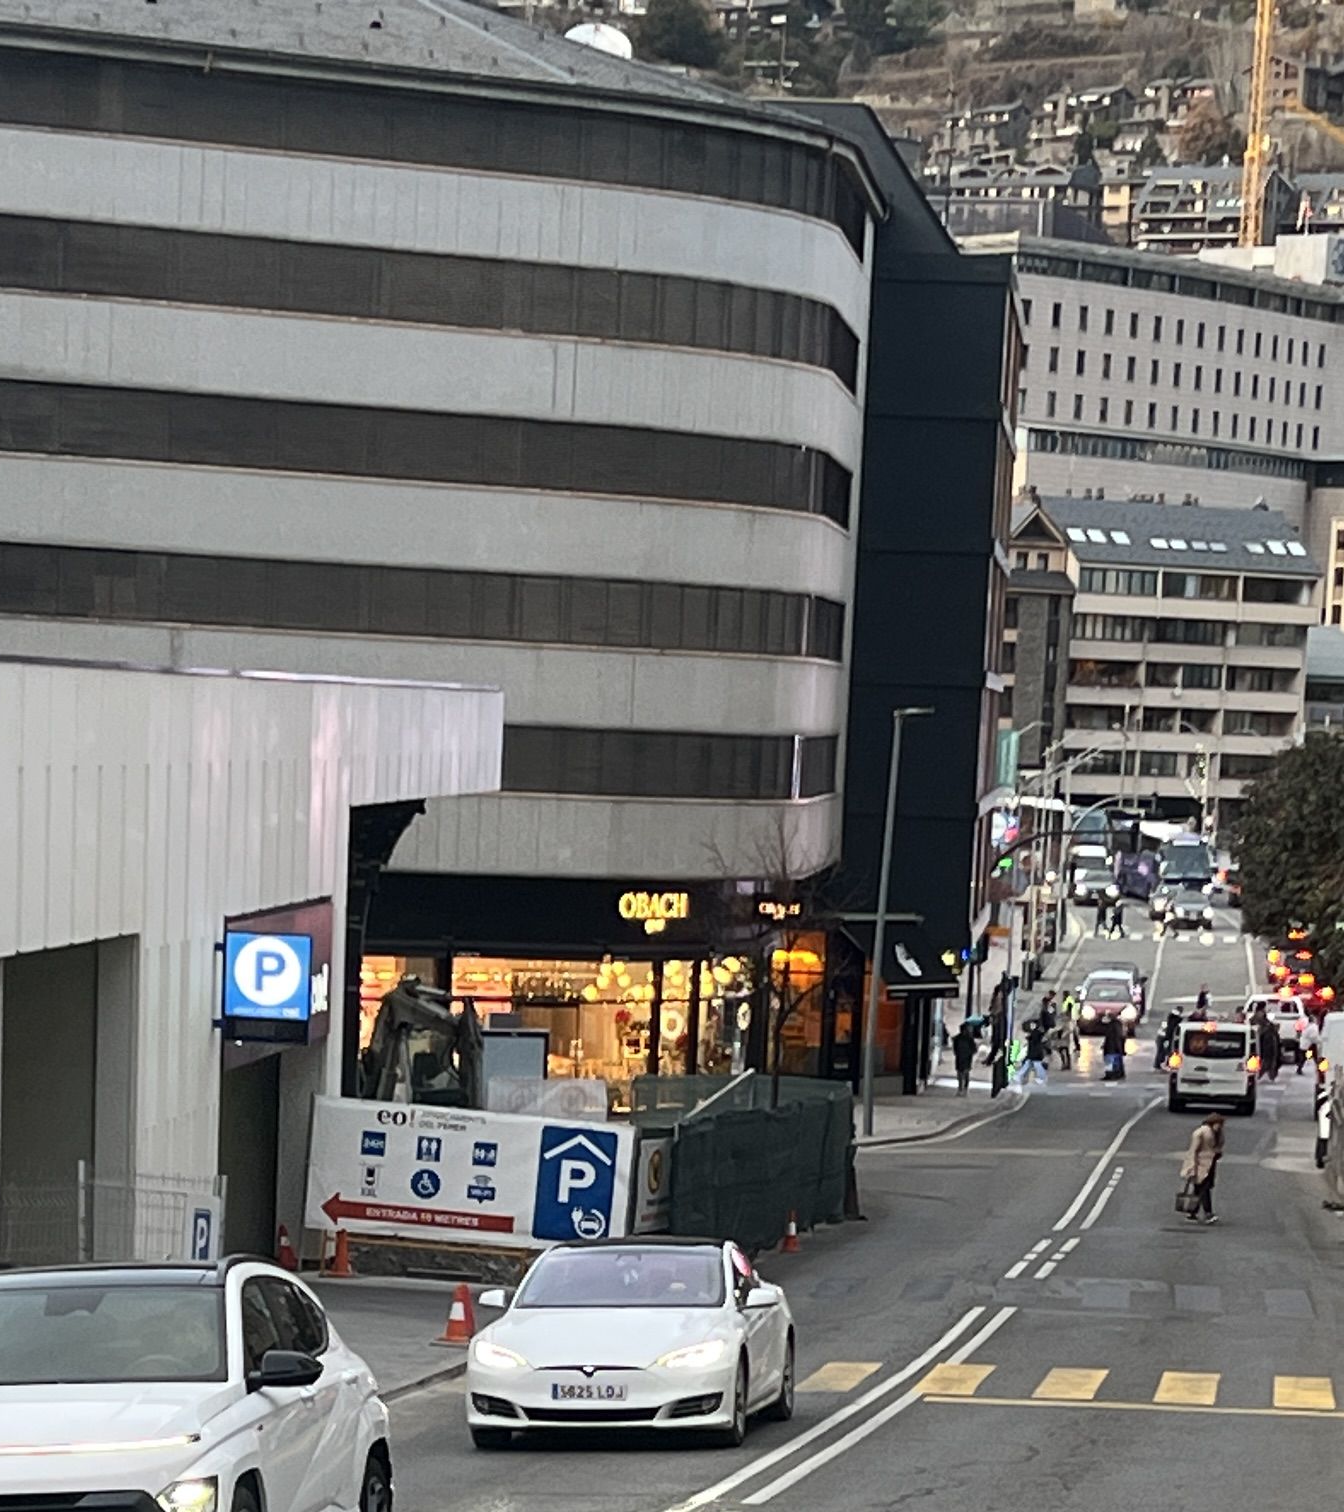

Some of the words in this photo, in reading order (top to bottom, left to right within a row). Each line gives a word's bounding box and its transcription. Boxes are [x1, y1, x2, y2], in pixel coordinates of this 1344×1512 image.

[618, 891, 690, 919] OBACH
[255, 950, 287, 992] P
[557, 1159, 596, 1203] P
[366, 1206, 418, 1222] ENTRADA
